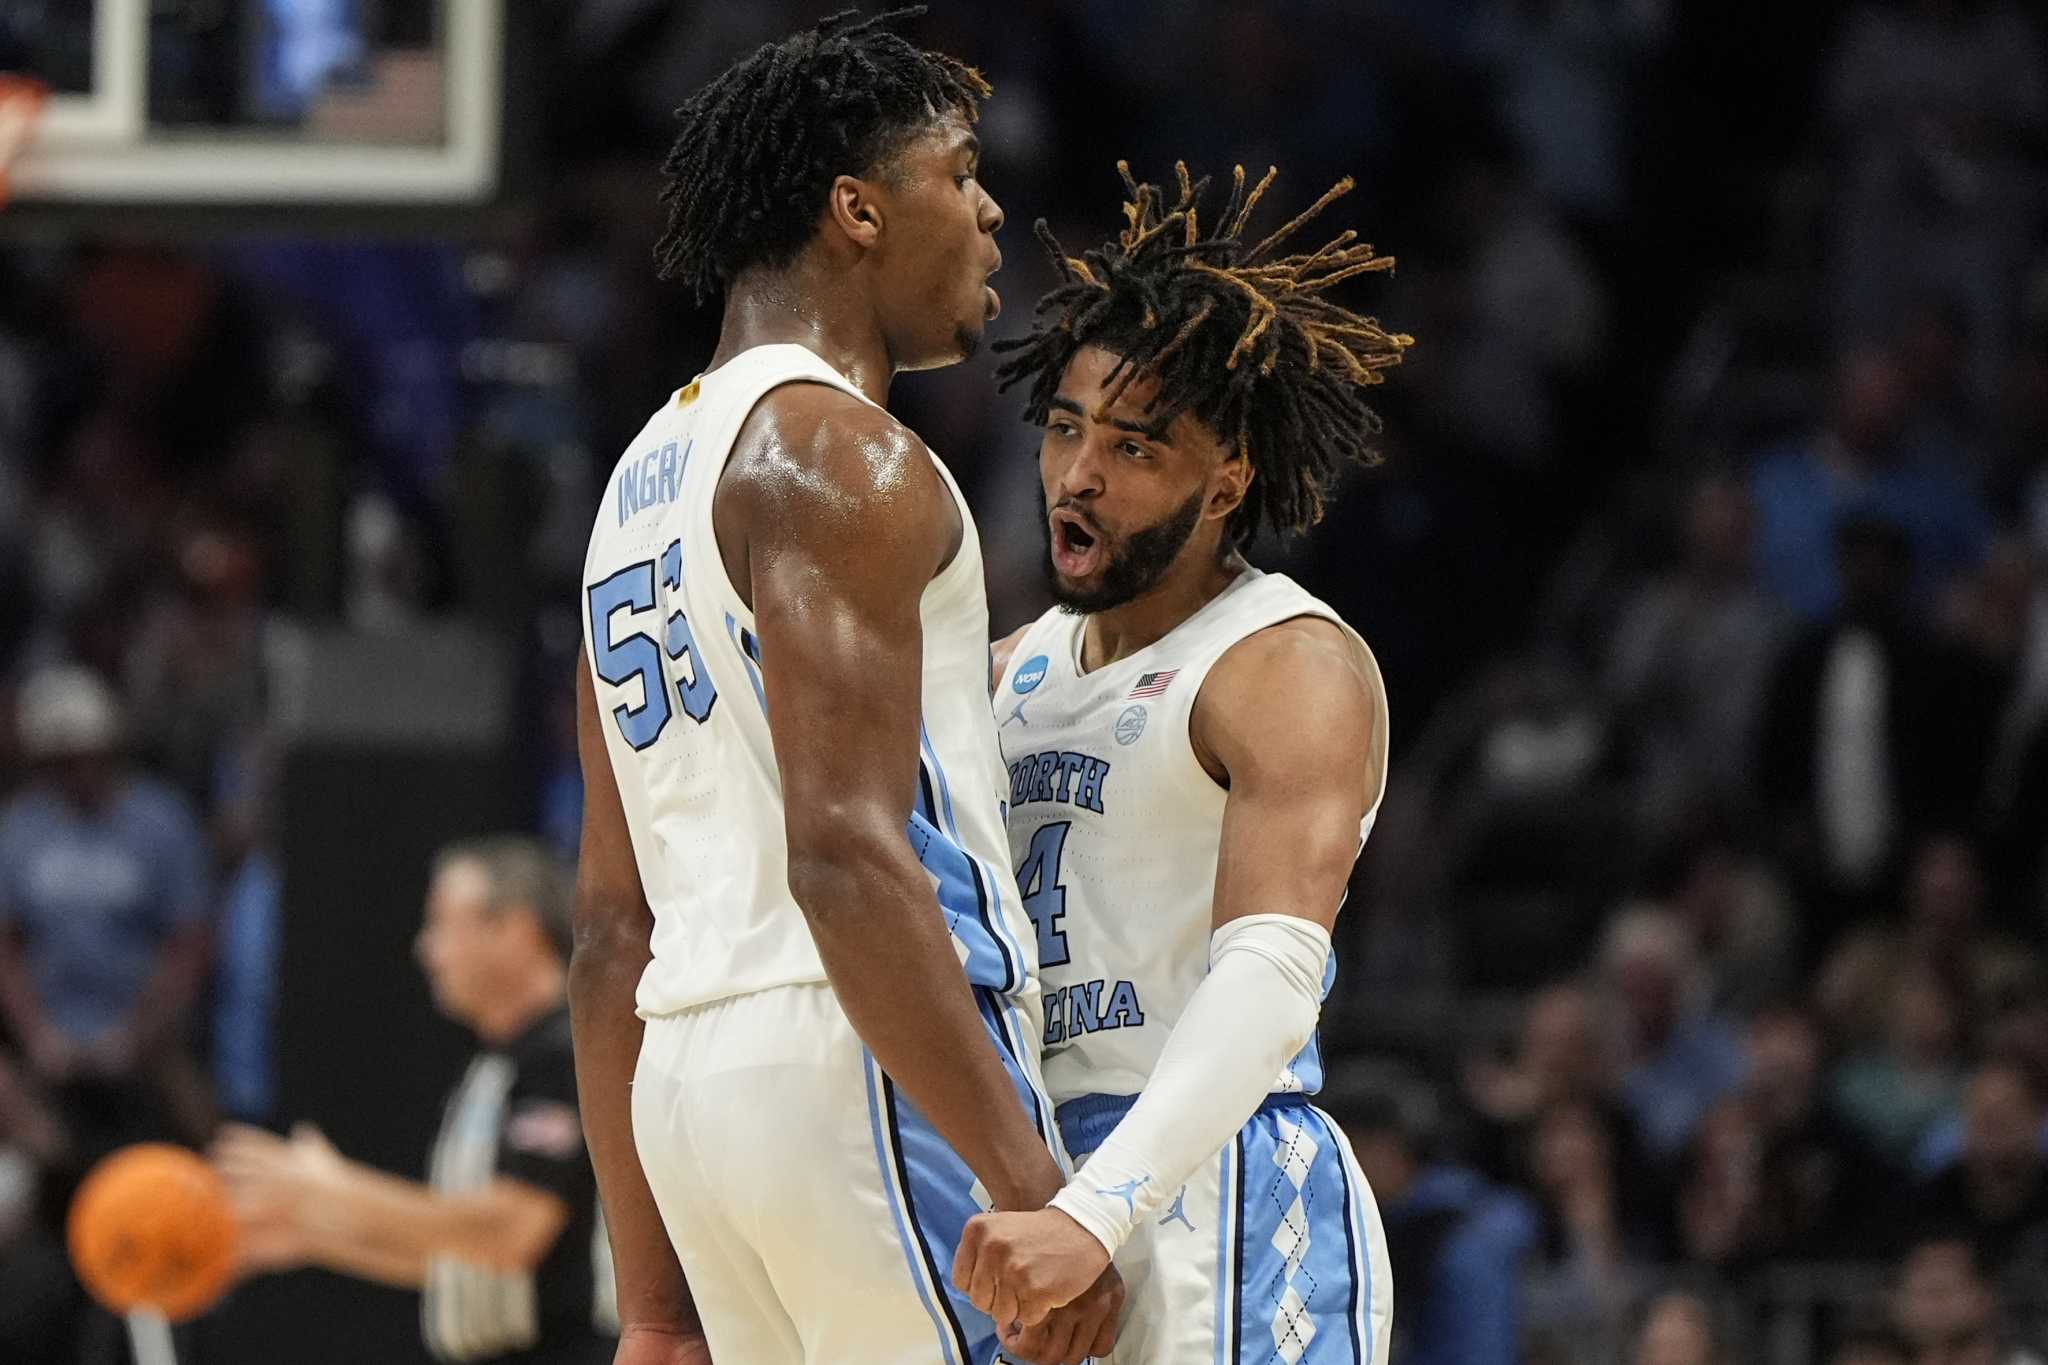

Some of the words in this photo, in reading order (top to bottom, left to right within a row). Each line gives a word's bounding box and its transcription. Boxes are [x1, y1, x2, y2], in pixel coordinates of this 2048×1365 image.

[1008, 750, 1110, 815] ORTH
[1015, 820, 1072, 969] 4
[1042, 979, 1145, 1046] LINA
